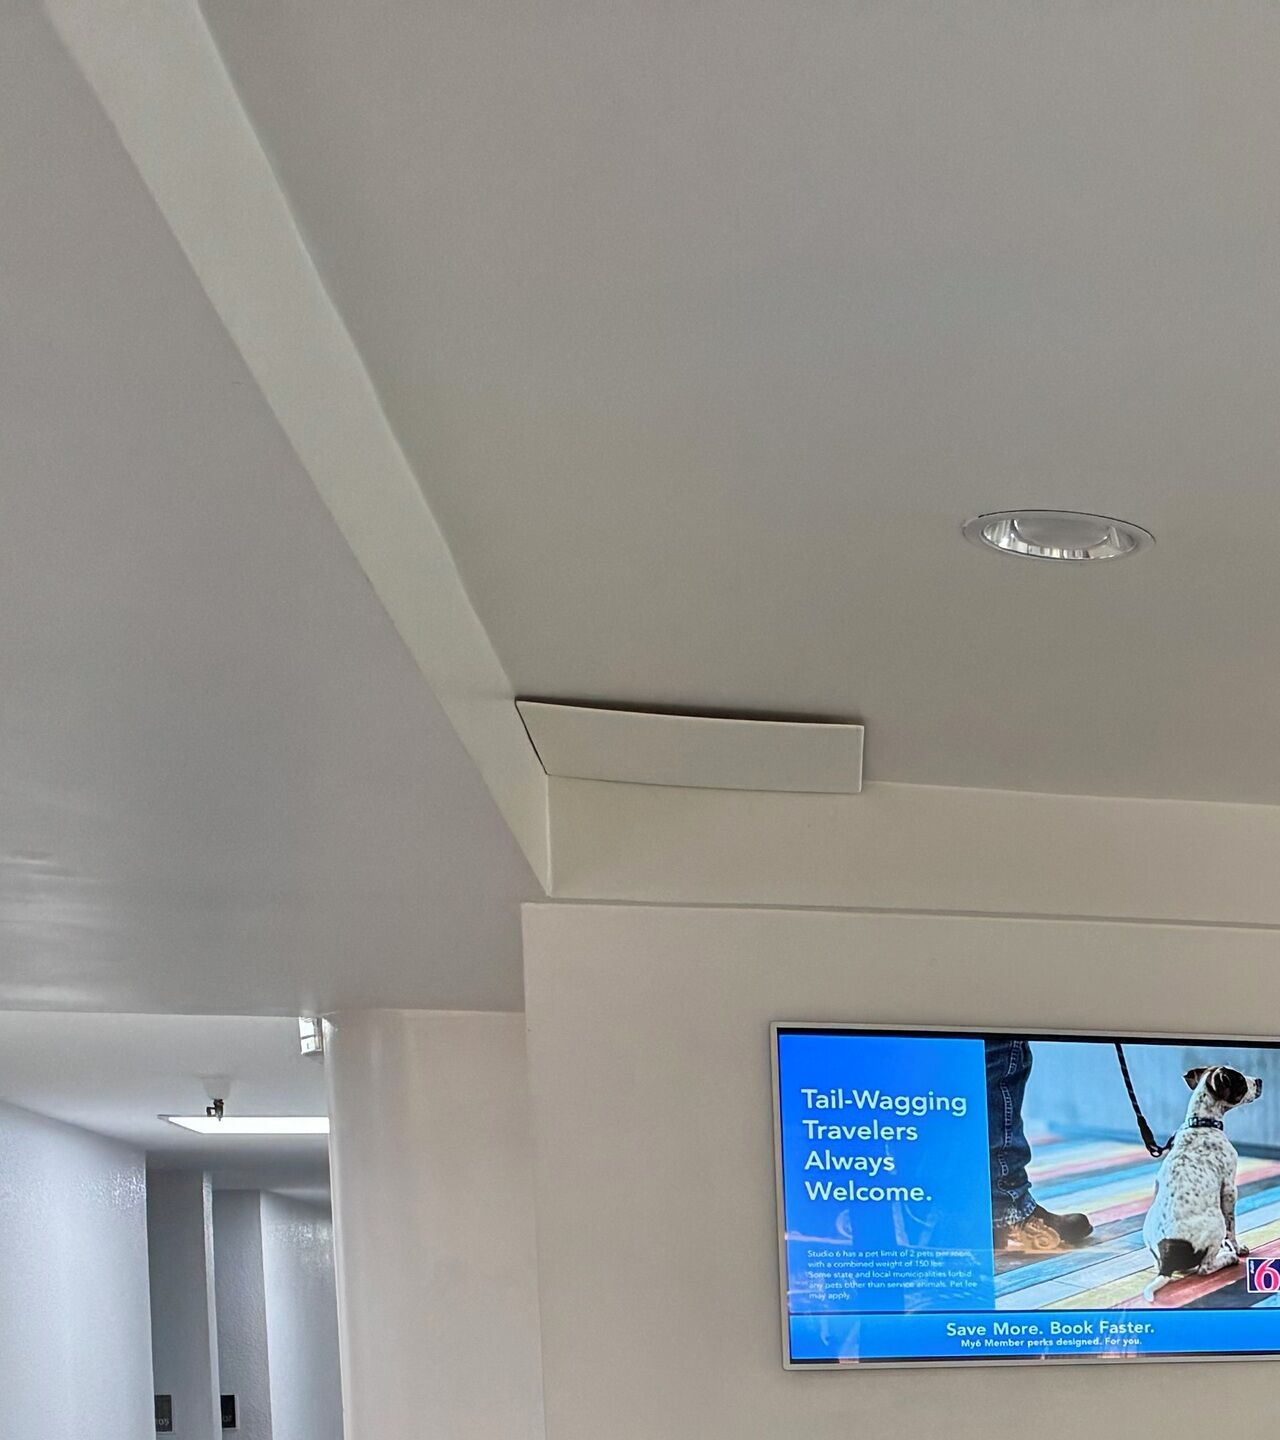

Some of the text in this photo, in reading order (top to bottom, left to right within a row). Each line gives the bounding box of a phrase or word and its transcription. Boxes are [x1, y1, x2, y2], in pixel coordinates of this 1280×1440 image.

[800, 1088, 967, 1117] Tail-Wagging
[802, 1119, 919, 1141] Travelers
[804, 1149, 895, 1177] Always
[804, 1180, 932, 1201] Welcome.
[1254, 1258, 1280, 1292] 6
[946, 1320, 1155, 1337] Save More. Book Faster.
[960, 1336, 1142, 1348] My6 Member perks designed. For you.
